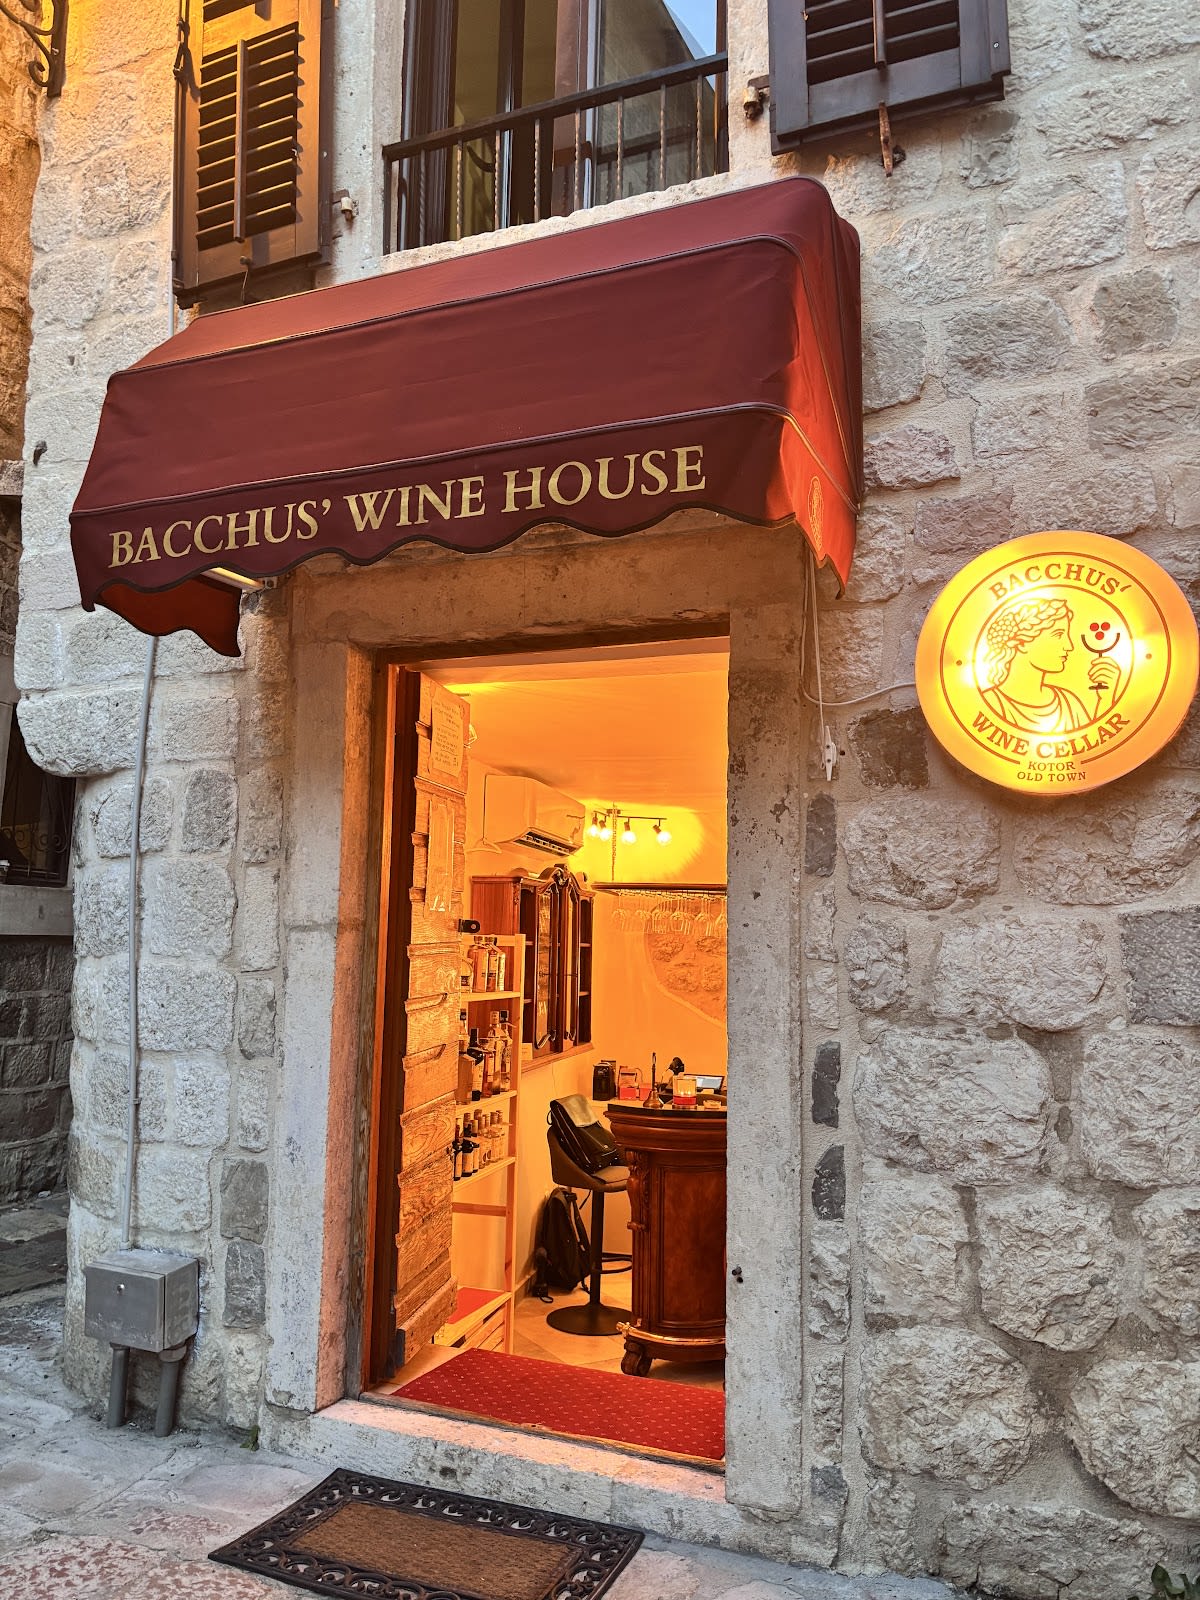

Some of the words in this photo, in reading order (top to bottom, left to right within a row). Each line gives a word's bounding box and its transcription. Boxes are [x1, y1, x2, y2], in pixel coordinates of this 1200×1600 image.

[108, 499, 332, 568] BACCHUS’
[342, 475, 486, 533] WINE
[500, 444, 707, 513] HOUSE
[989, 563, 1132, 600] BACCHUS'
[971, 710, 1030, 757] WINE
[1036, 712, 1131, 759] CELLAR
[1017, 771, 1043, 782] OLD
[1048, 771, 1087, 782] TOWN
[1027, 760, 1076, 771] KOTOR
